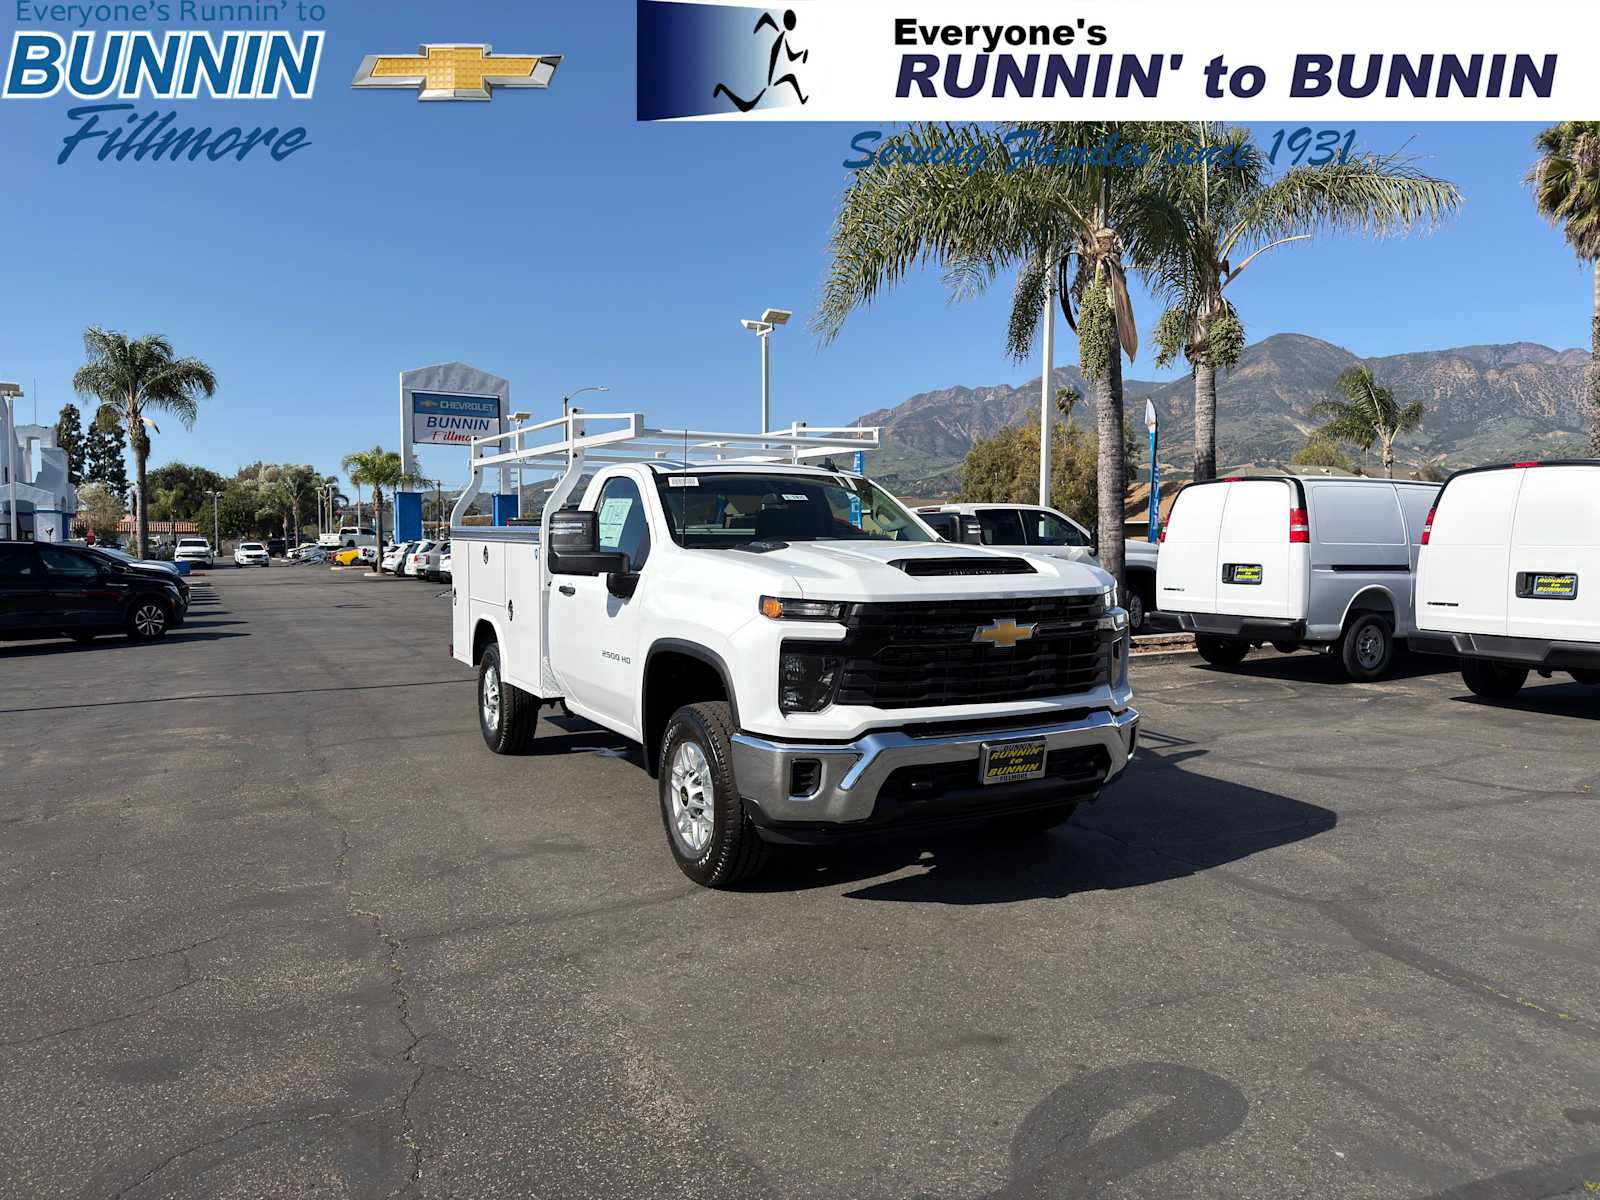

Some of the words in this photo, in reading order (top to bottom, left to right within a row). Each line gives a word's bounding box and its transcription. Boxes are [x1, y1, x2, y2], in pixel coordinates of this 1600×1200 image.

[440, 400, 496, 412] CHEVROLET
[426, 416, 489, 430] BUNNIN
[432, 430, 472, 442] Fillmo
[602, 650, 620, 661] 2500
[988, 762, 1041, 776] BUNNIN
